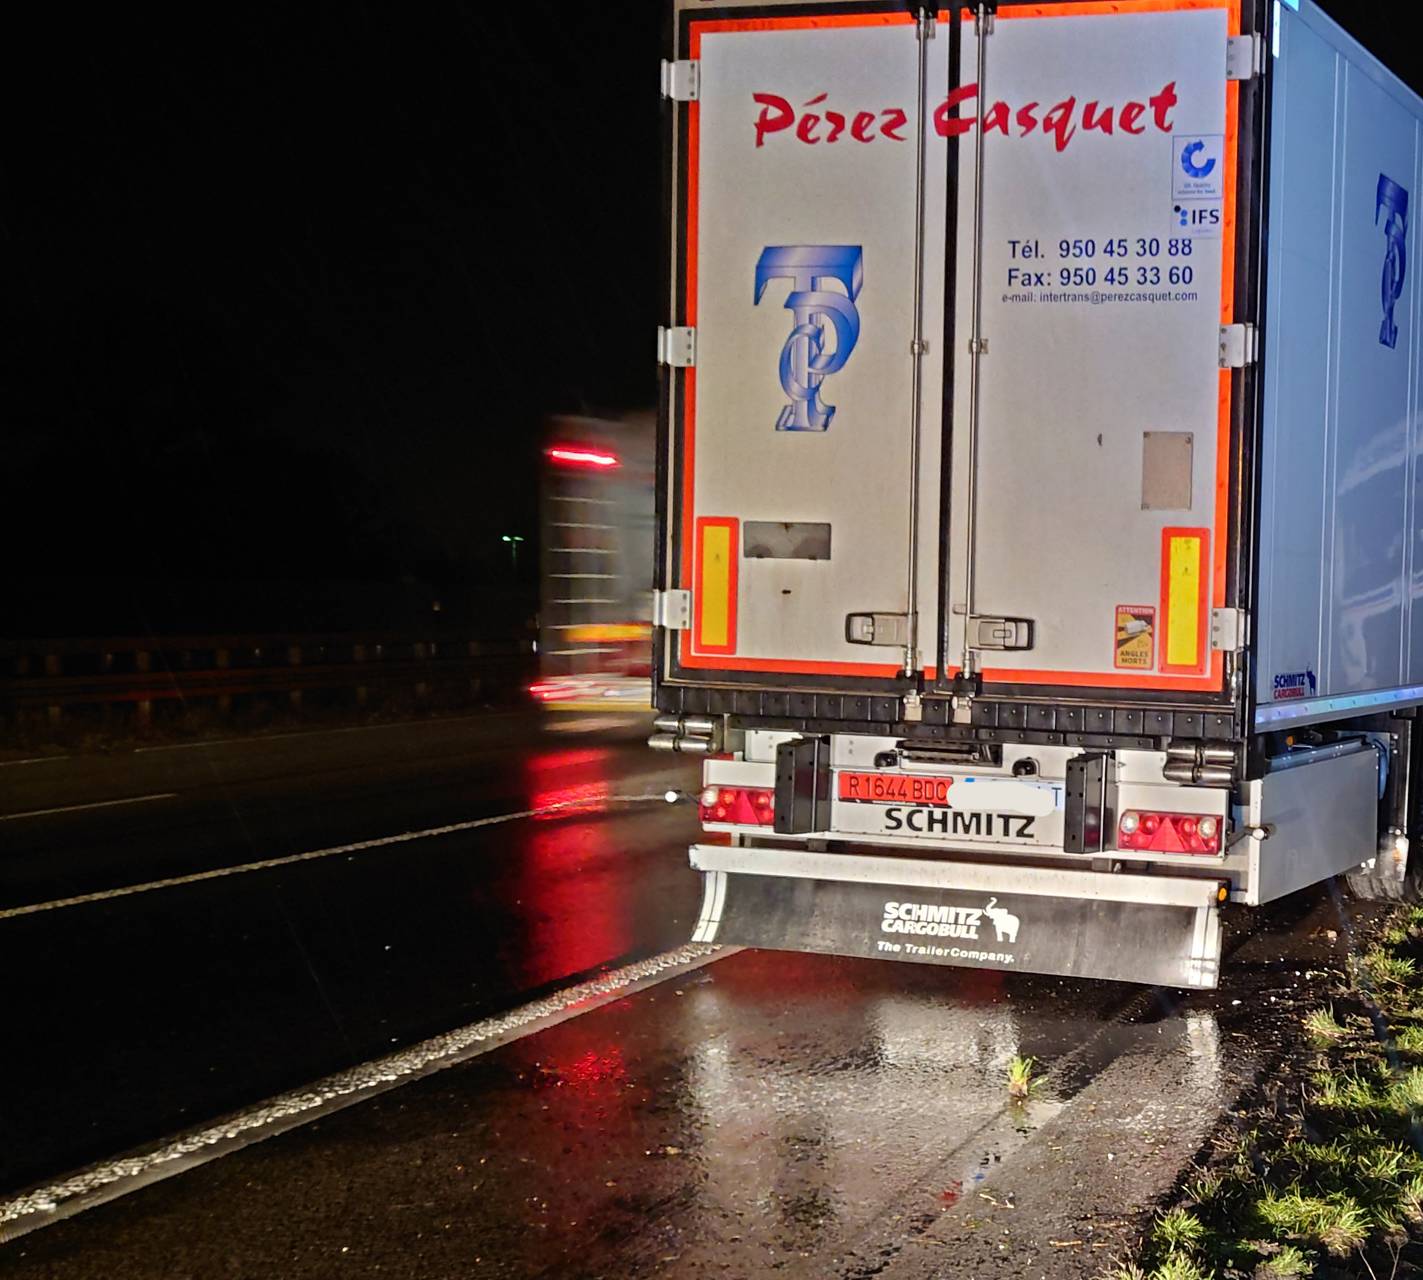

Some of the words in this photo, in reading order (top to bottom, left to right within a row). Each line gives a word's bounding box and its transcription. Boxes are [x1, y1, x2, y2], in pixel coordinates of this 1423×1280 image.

[752, 92, 908, 148] Pérez
[933, 81, 1178, 152] Casquet
[1192, 209, 1219, 224] IFS
[1008, 240, 1045, 258] Tél.
[1059, 239, 1096, 258] 950
[1103, 239, 1128, 257] 45
[1135, 238, 1160, 257] 30
[1168, 238, 1192, 257] 88
[1007, 268, 1051, 287] Fax:
[1059, 267, 1096, 286] 950
[1104, 267, 1128, 286] 45
[1136, 266, 1160, 285] 33
[1168, 266, 1193, 285] 60
[1002, 292, 1036, 302] e-mail:
[1039, 291, 1198, 304] intertrans@perezcasquet.com
[1274, 673, 1305, 688] SCHMITZ
[850, 776, 860, 796] R
[865, 776, 907, 799] 1644
[885, 808, 1035, 838] SCHMITZ
[883, 902, 983, 926] SCHMITZ
[881, 919, 979, 940] CARGOBULL
[877, 941, 901, 952] The
